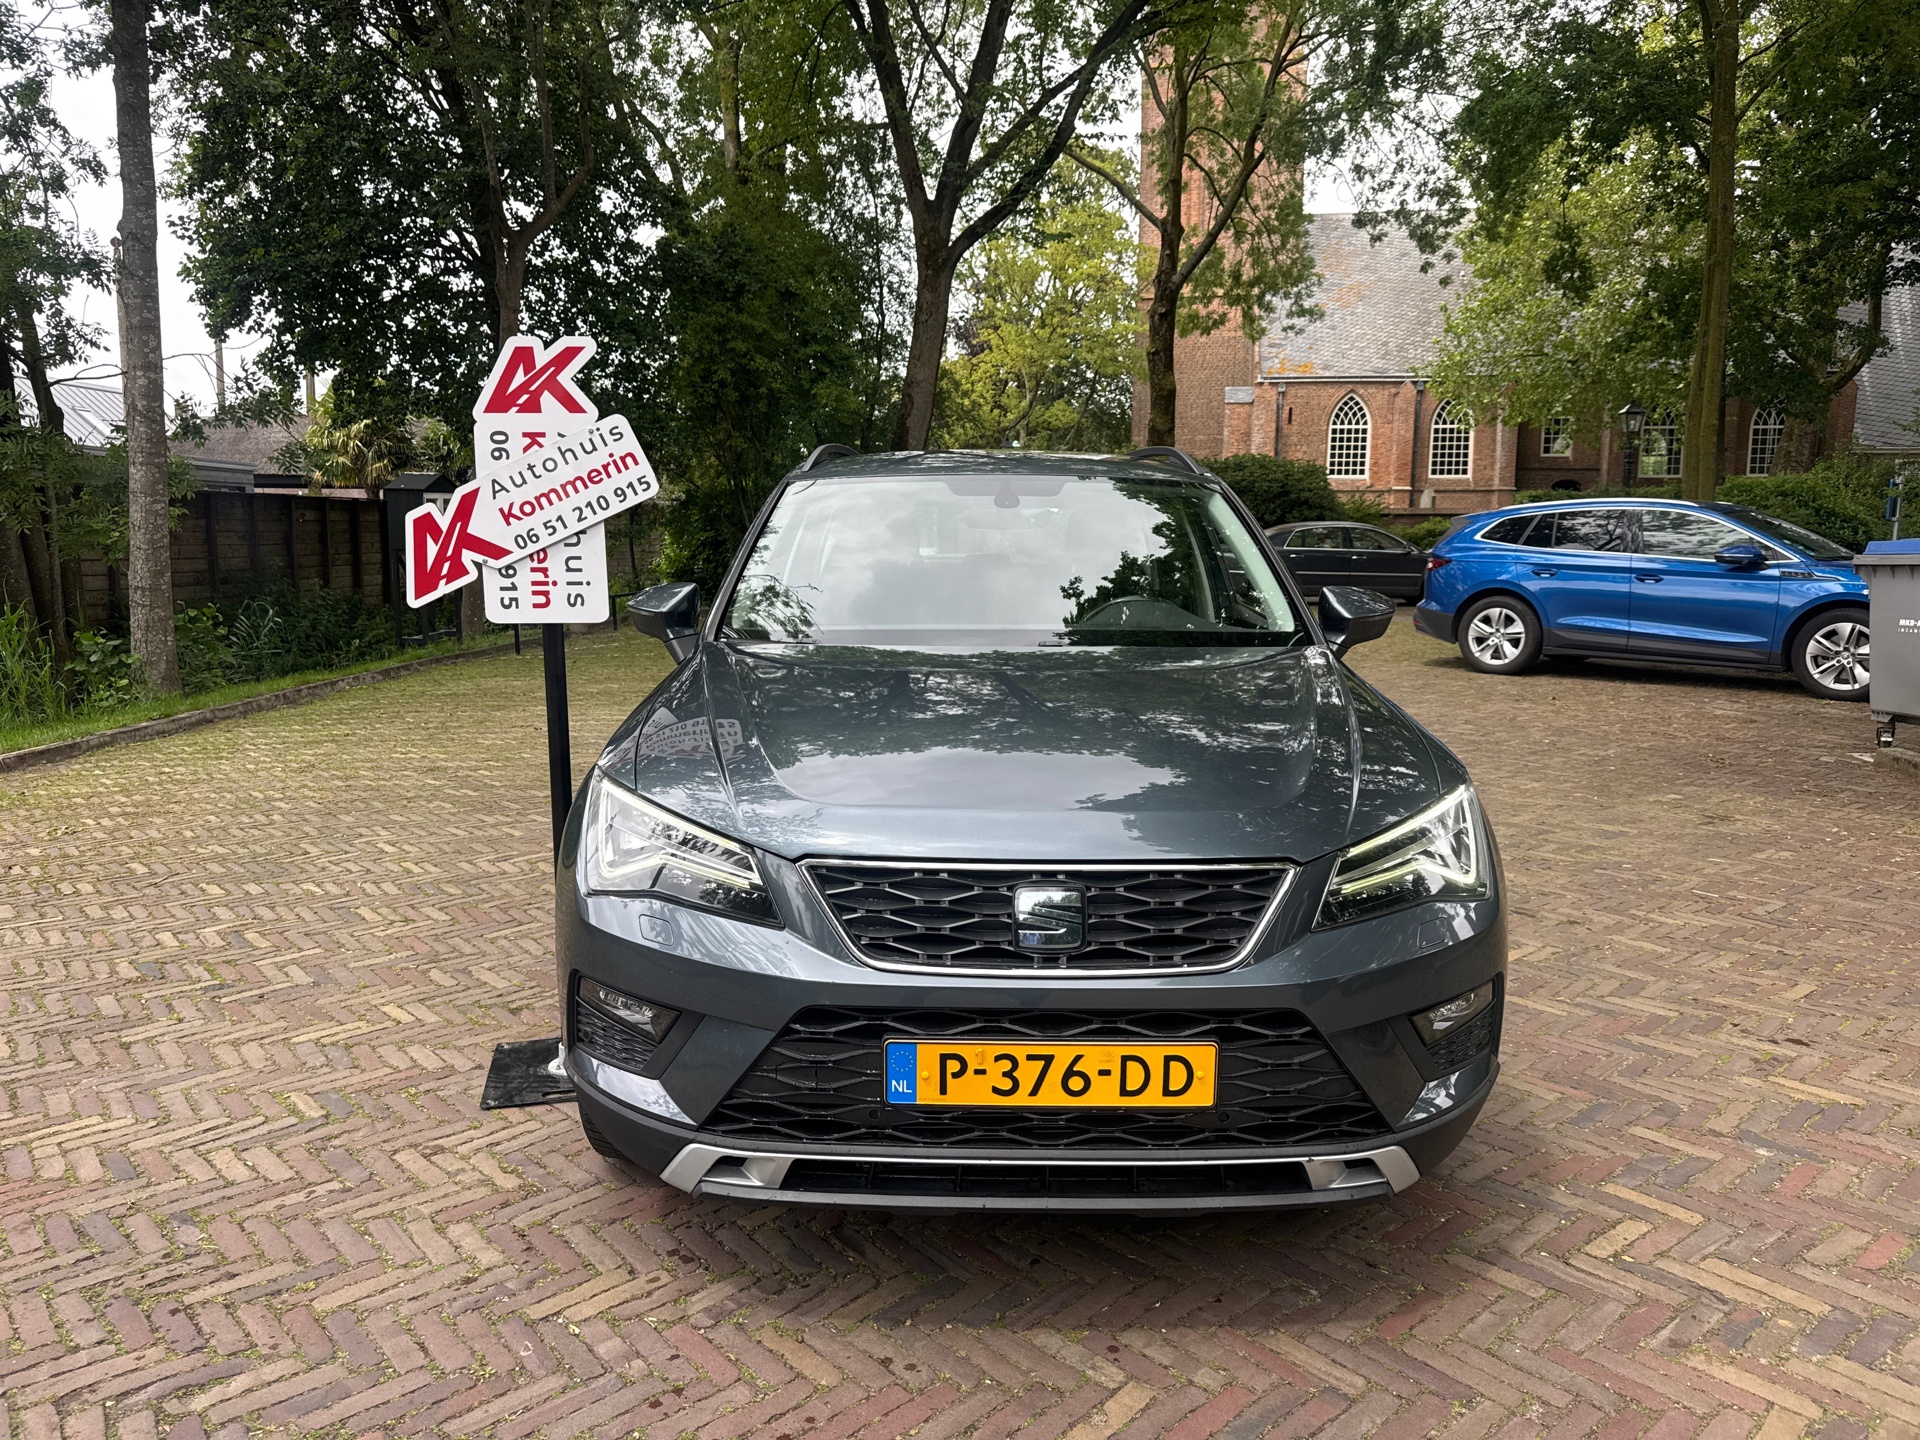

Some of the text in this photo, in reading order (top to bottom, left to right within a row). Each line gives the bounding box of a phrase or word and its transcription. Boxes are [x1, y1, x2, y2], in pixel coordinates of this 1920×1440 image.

[490, 426, 625, 501] Autohuis
[498, 452, 640, 527] Kommerin
[489, 430, 519, 610] 06 915
[514, 474, 652, 550] 06 51 210 915
[891, 1079, 913, 1093] NL
[939, 1052, 1194, 1097] P-376-DD
